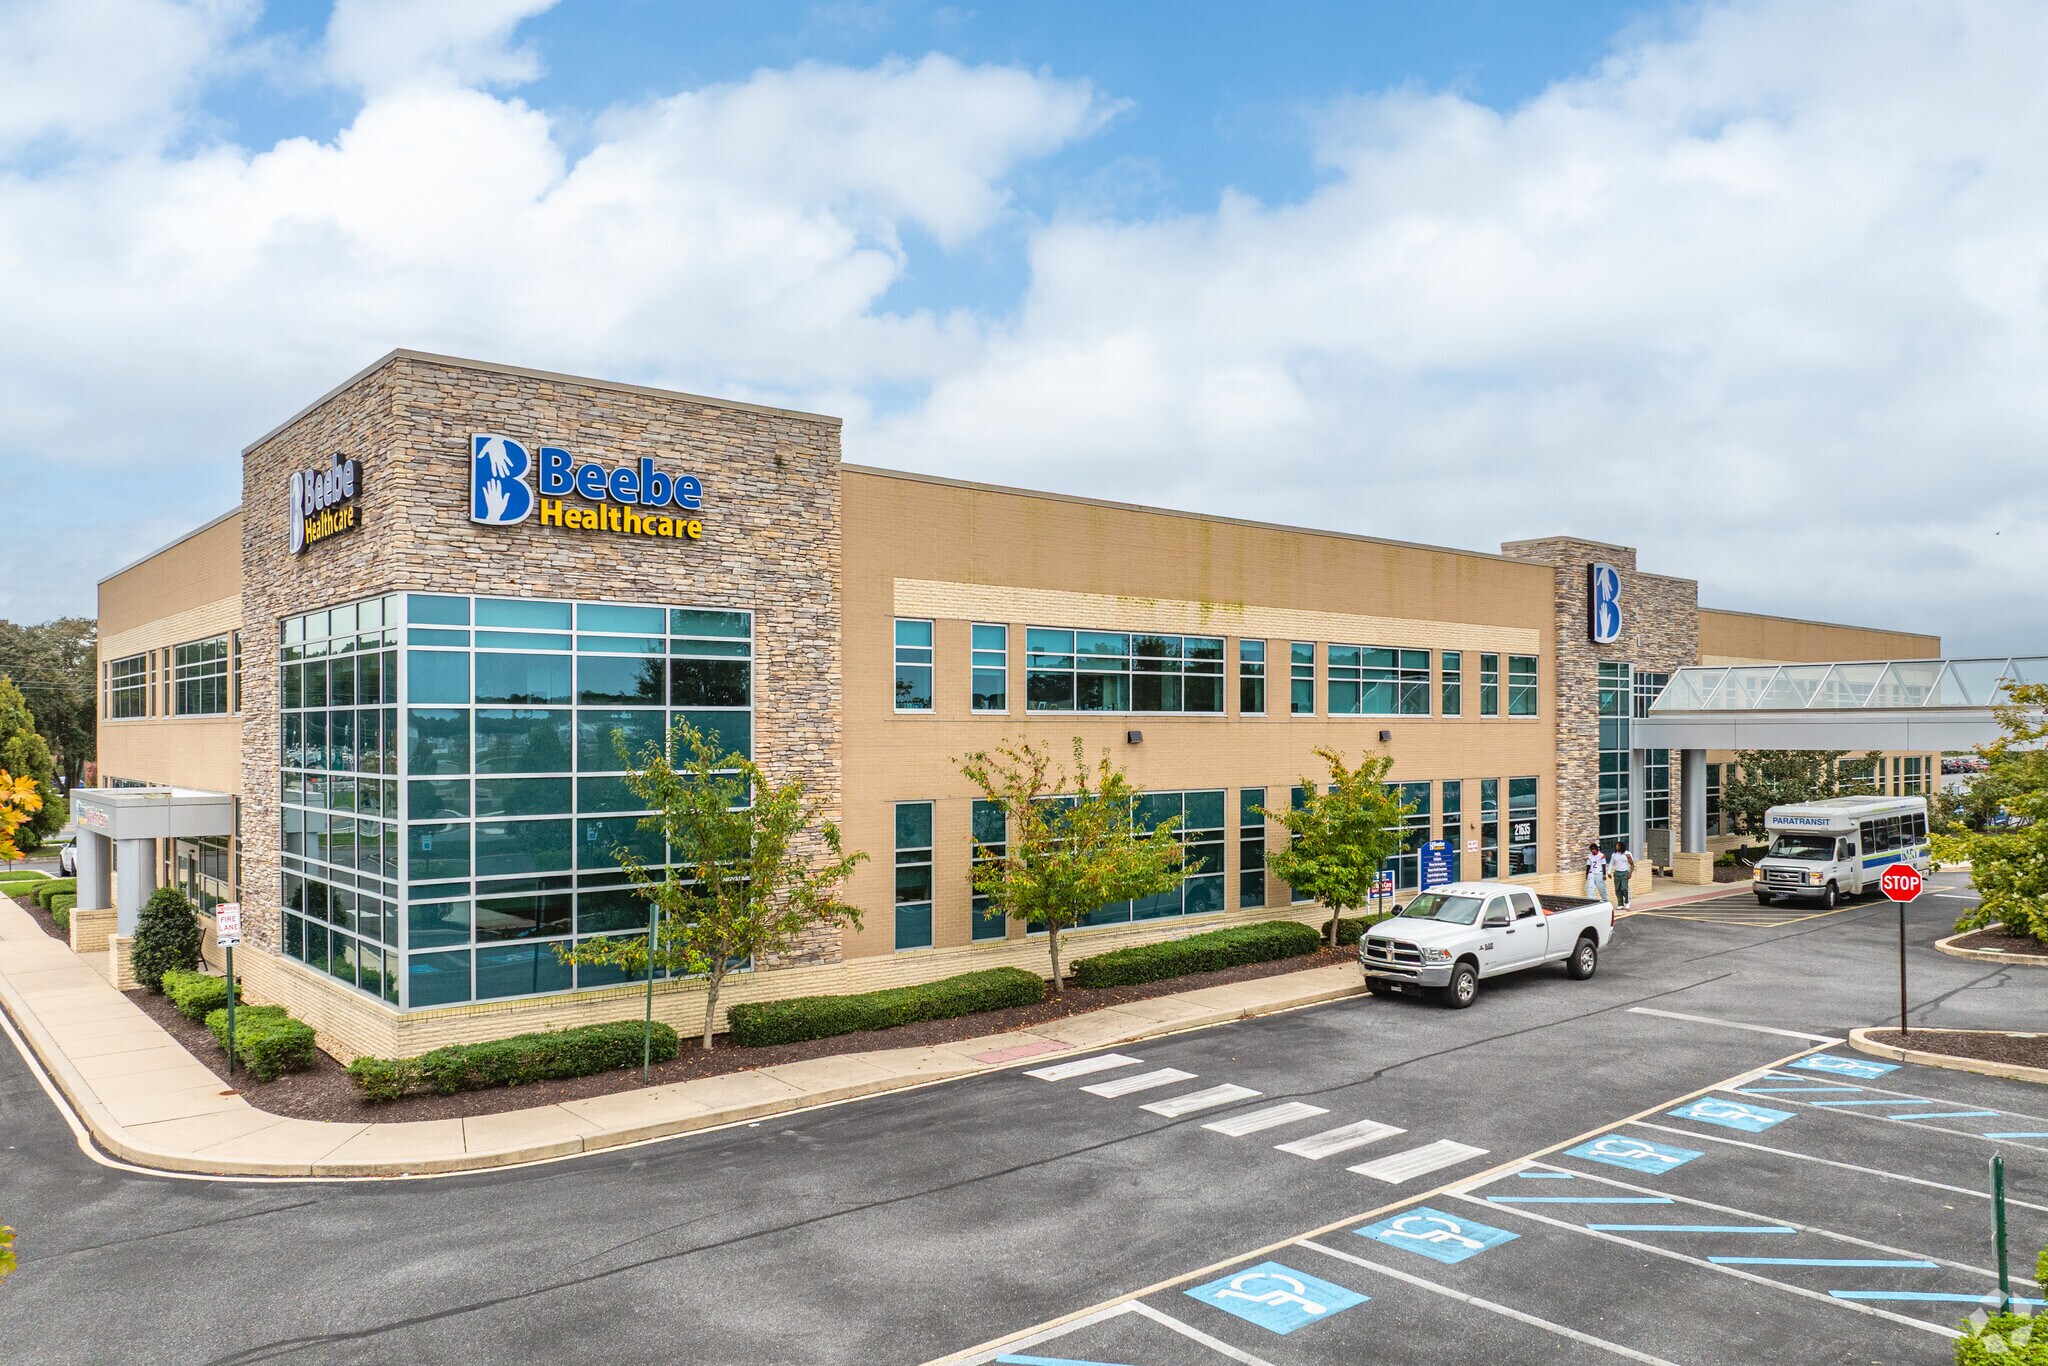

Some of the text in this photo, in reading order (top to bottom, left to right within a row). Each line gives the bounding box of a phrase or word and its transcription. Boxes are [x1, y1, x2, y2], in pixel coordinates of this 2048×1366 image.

[303, 453, 357, 509] Beebe
[539, 446, 704, 510] Beebe
[305, 507, 355, 545] Healthcare
[539, 499, 704, 539] Healthcare
[1772, 817, 1831, 826] PARATRANSIT
[1883, 875, 1920, 891] STOP
[219, 924, 239, 932] LANE
[220, 915, 237, 923] FIRE
